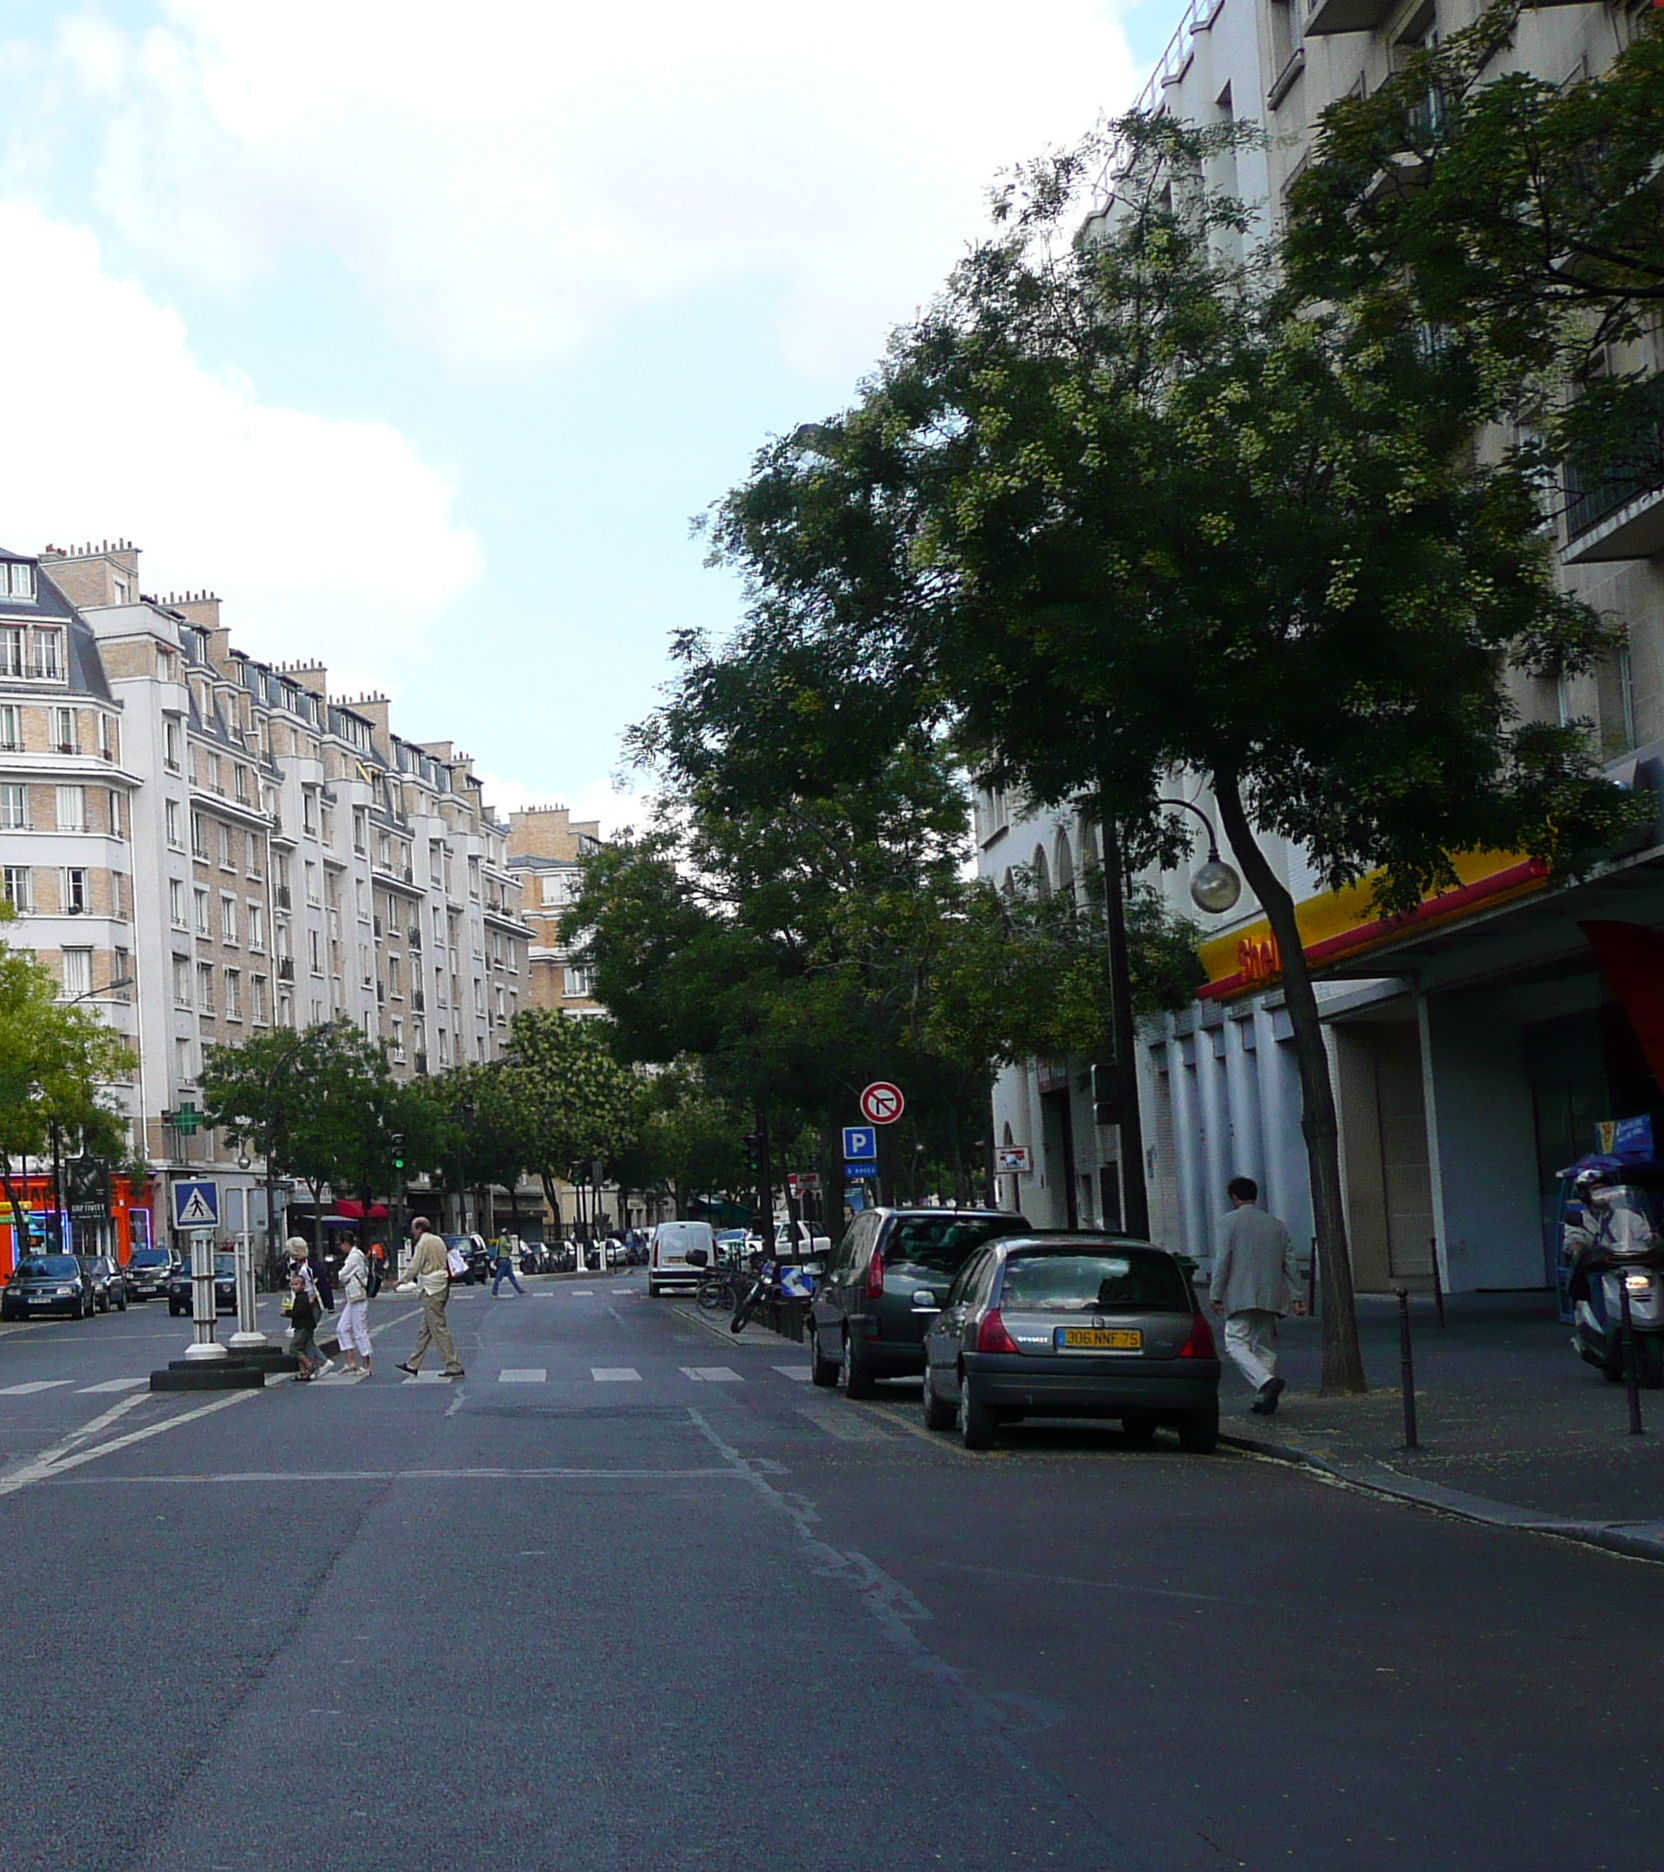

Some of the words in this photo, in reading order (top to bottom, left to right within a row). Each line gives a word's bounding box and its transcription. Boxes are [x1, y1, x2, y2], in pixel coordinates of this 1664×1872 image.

[1237, 931, 1282, 982] Shel
[851, 1133, 867, 1153] P
[1067, 1331, 1091, 1345] 306
[1094, 1332, 1118, 1345] NNF
[1122, 1332, 1139, 1346] 75
